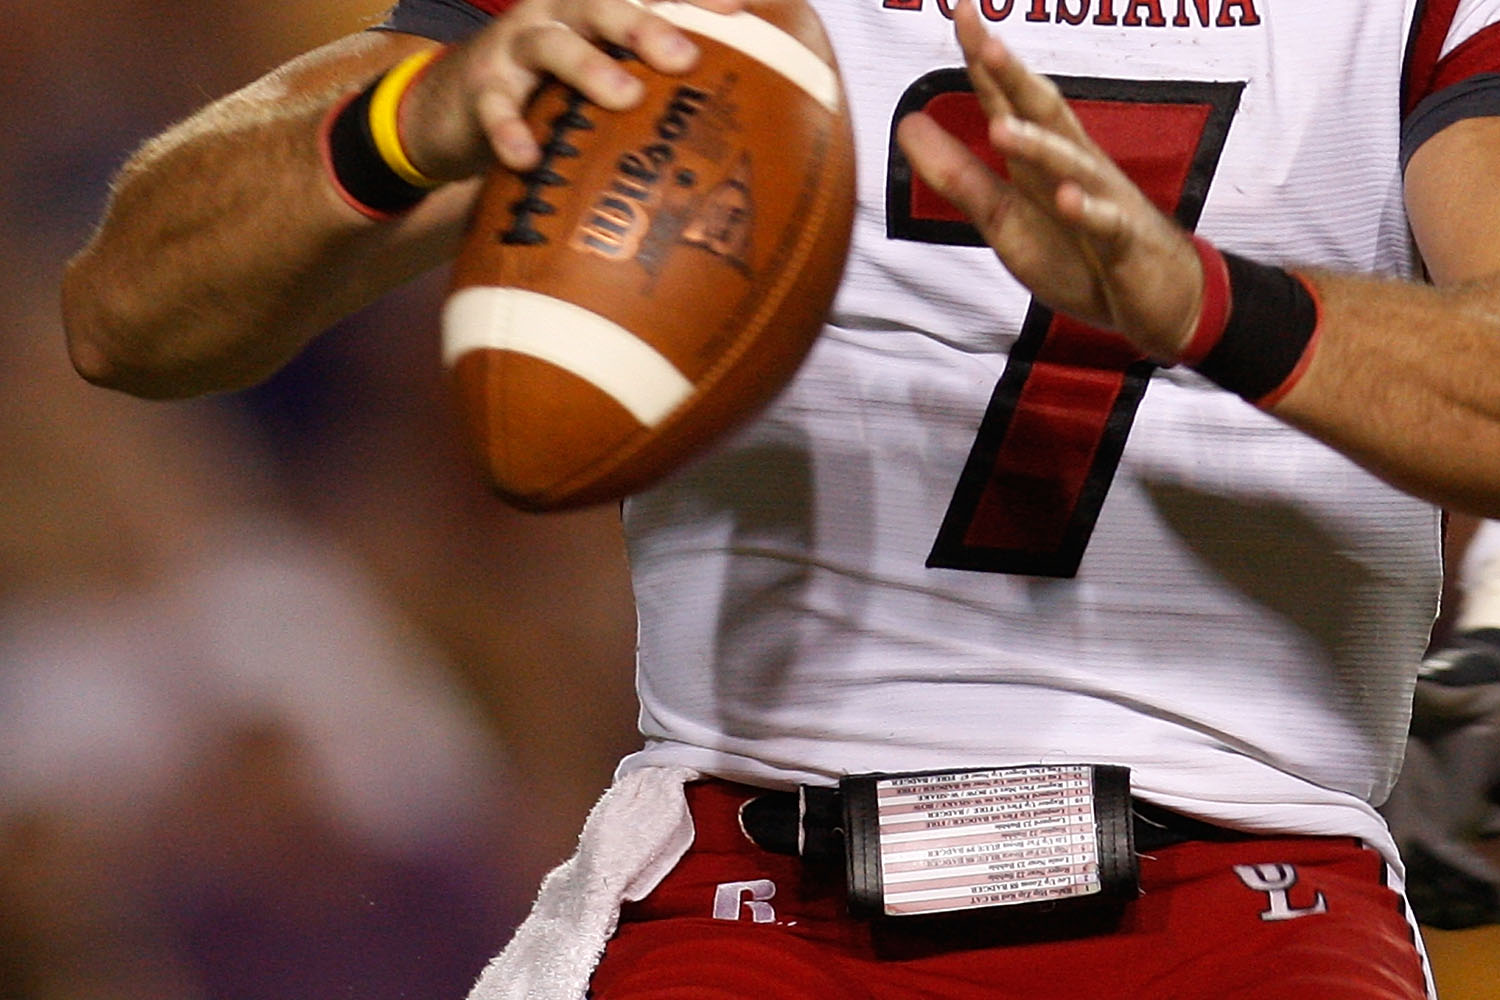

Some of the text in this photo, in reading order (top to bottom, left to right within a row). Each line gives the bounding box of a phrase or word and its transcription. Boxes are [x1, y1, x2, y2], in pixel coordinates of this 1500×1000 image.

[566, 83, 714, 262] Wilson
[885, 66, 1249, 578] 7
[713, 879, 776, 923] R
[971, 884, 1007, 893] BADGER
